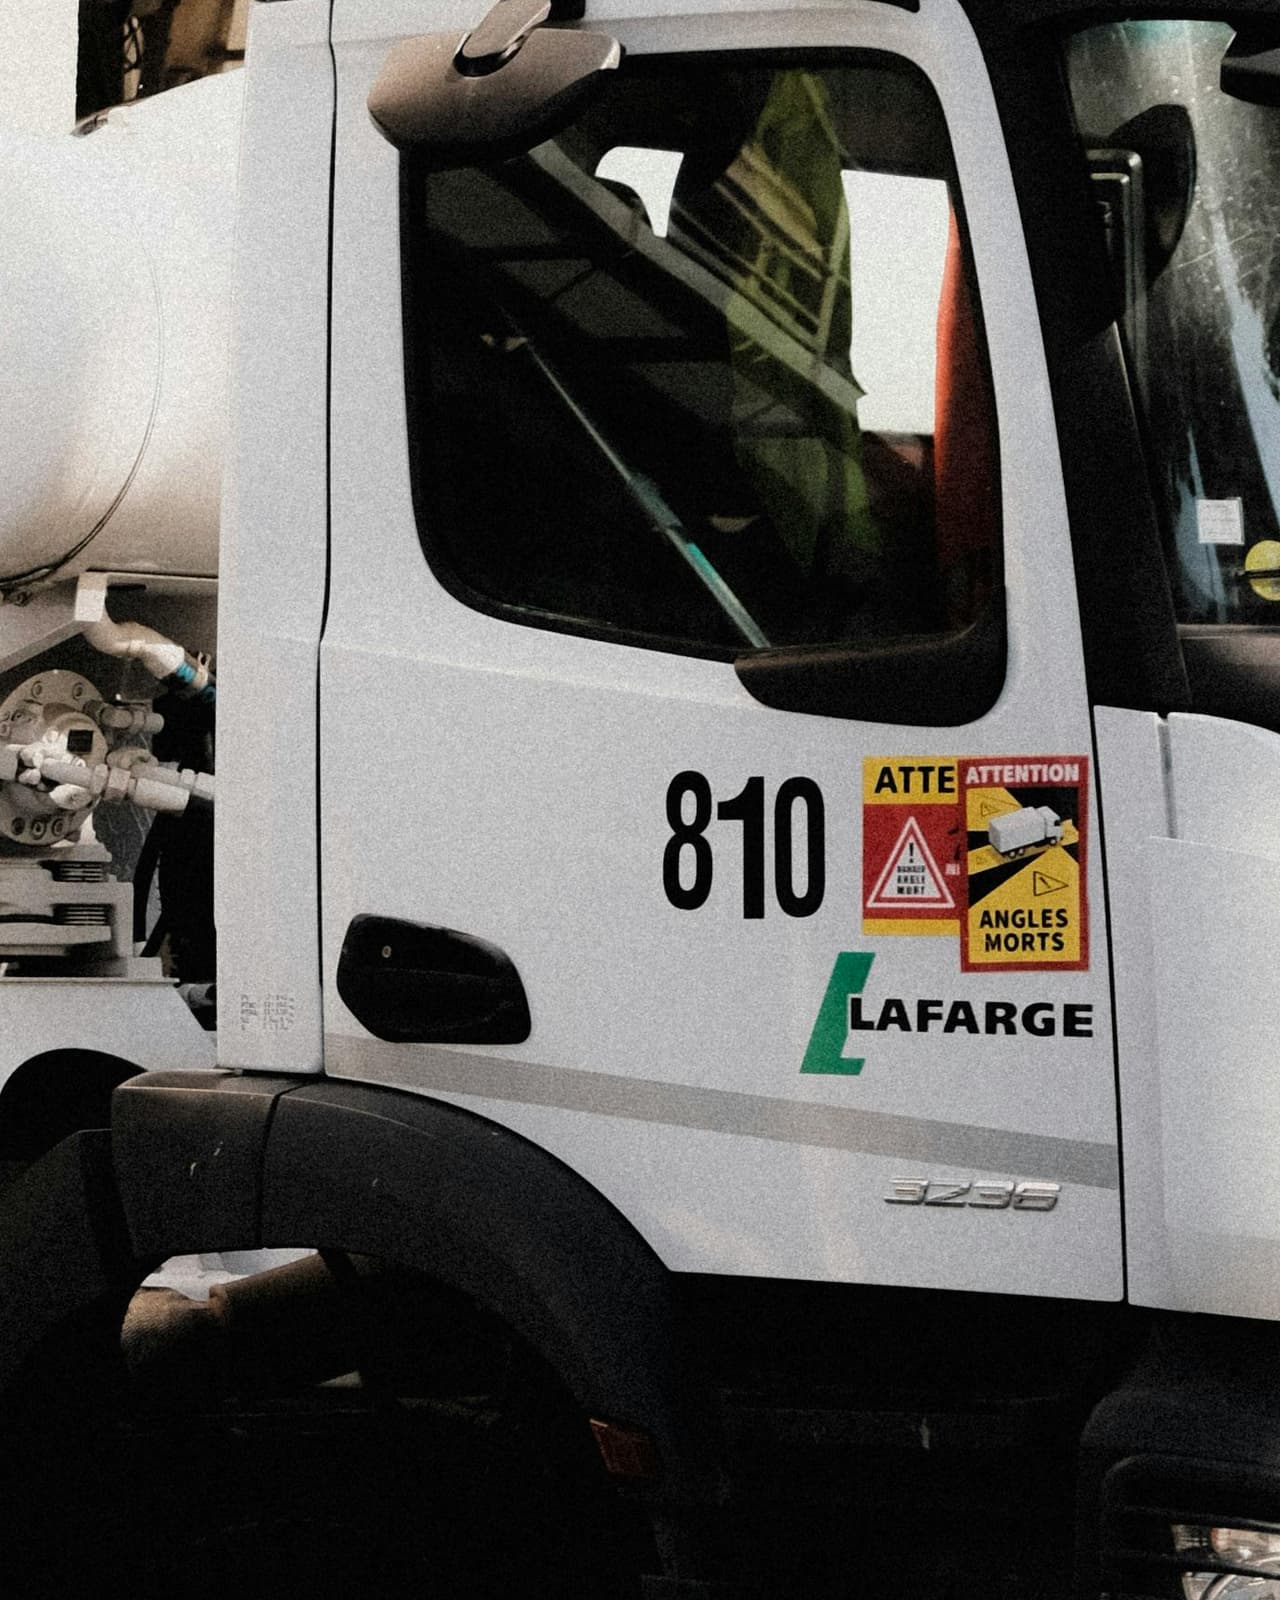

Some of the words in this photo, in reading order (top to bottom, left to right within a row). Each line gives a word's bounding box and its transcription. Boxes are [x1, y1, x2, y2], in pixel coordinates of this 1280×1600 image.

[965, 763, 1080, 785] ATTENTION
[662, 770, 826, 920] 810
[980, 908, 1069, 929] ANGLES
[984, 933, 1065, 952] MORTS
[850, 997, 1094, 1038] LAFARGE
